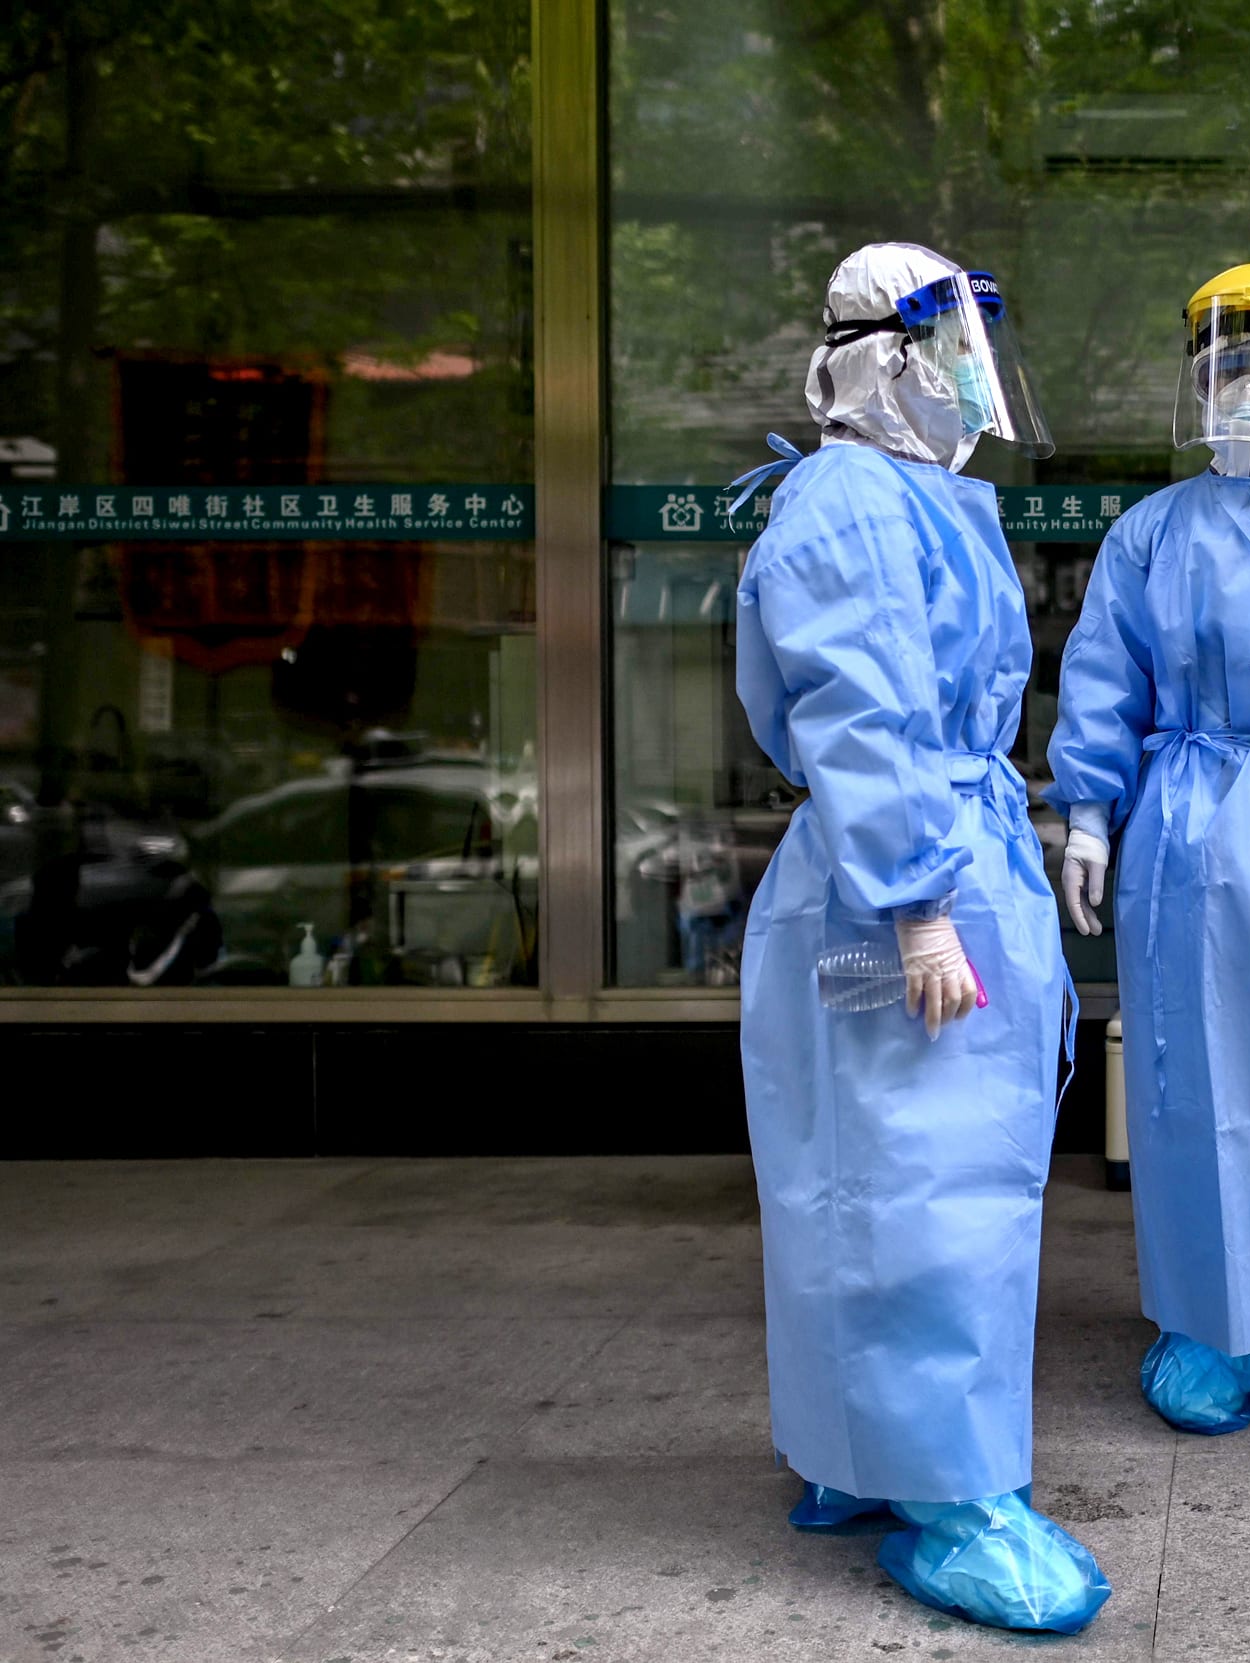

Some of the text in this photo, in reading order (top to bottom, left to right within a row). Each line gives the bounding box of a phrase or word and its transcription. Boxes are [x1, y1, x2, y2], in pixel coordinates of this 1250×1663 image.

[20, 494, 525, 517] 江岸区四唯街社区卫生服务中心
[345, 518, 398, 530] Health
[404, 518, 464, 530] Service
[469, 517, 524, 530] Center
[1051, 518, 1104, 531] Health
